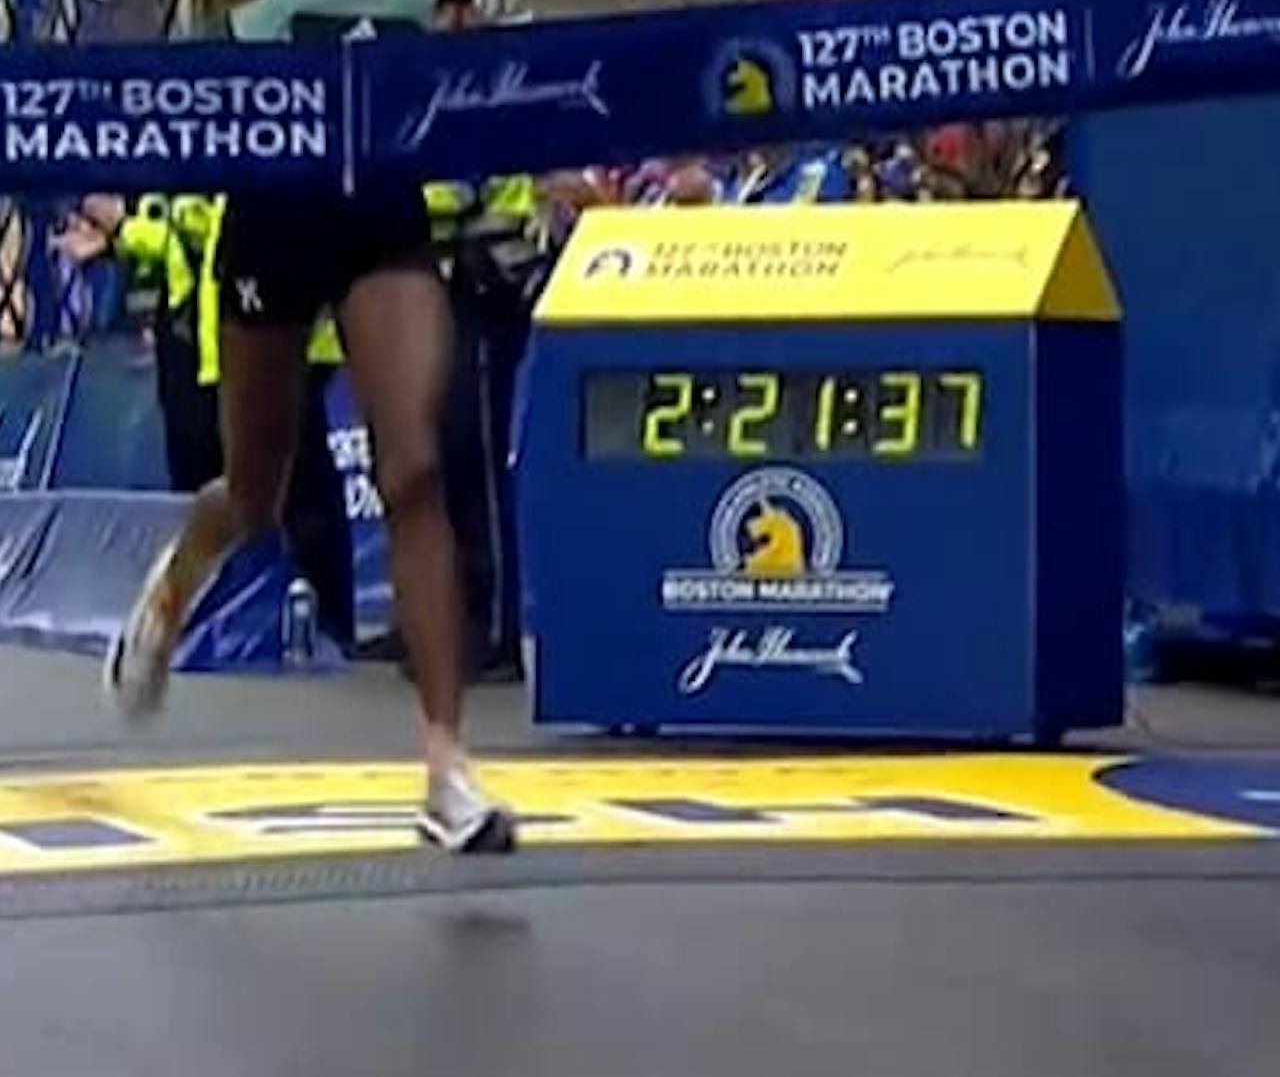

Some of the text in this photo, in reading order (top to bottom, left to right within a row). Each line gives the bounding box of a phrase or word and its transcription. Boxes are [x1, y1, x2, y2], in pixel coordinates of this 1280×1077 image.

[797, 8, 1069, 68] 127TH BOSTON
[0, 77, 328, 118] 127TH BOSTON
[802, 50, 1070, 109] MARATHON
[3, 120, 328, 163] MARATHON
[641, 372, 984, 455] 2:21:37
